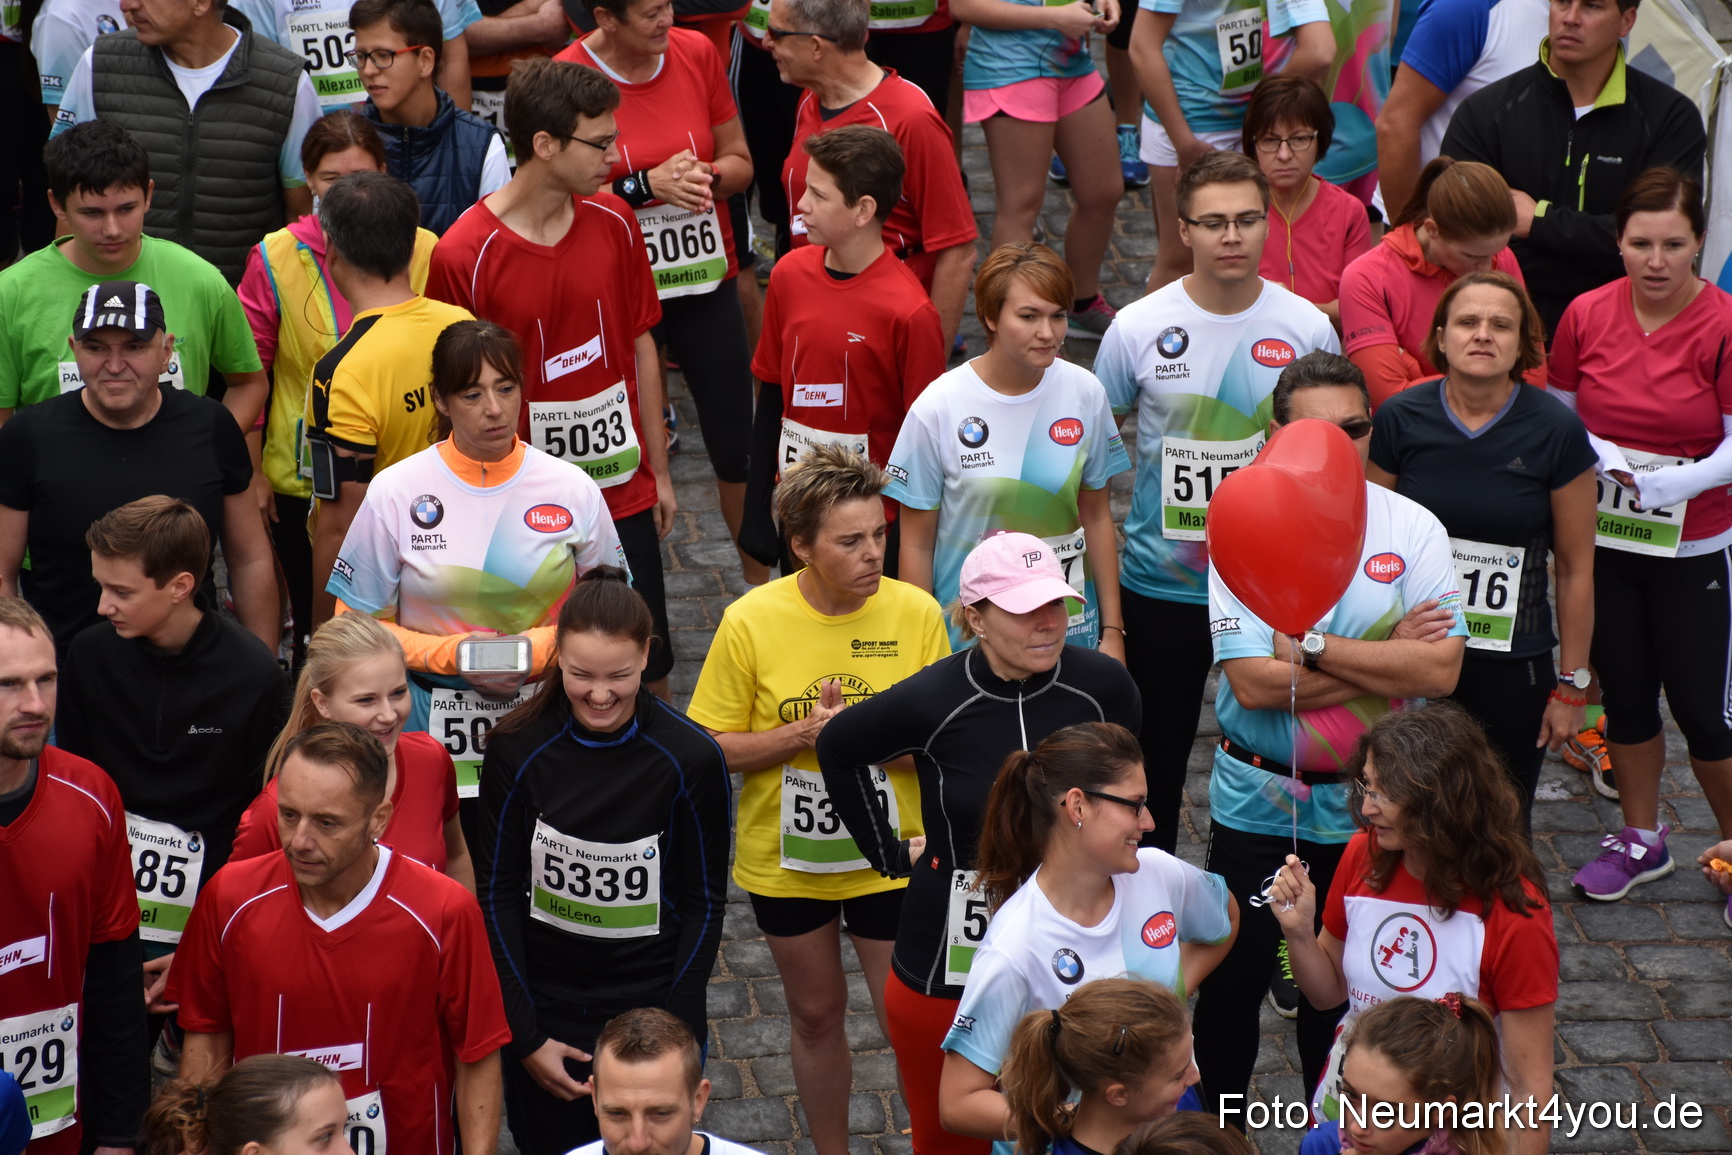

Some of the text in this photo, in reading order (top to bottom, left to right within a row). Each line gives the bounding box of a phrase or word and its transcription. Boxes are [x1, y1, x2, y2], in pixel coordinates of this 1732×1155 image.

[290, 23, 323, 34] PARTL
[1219, 19, 1250, 32] PARTL
[643, 220, 716, 266] 5066
[659, 269, 708, 287] Martina
[562, 350, 588, 368] DEHN
[1257, 344, 1292, 361] Hervis
[1155, 363, 1190, 374] PARTL
[1155, 372, 1190, 381] Neumarkt
[403, 387, 425, 413] SV
[804, 391, 827, 401] DEHN
[533, 399, 614, 422] PARTL Neumarkt
[545, 410, 627, 458] 5033
[783, 427, 803, 444] PARTL
[1054, 424, 1081, 439] Hervis
[960, 451, 994, 463] PARTL
[1166, 447, 1254, 461] PARTL Neumarkt
[961, 460, 995, 470] Neumarkt
[531, 511, 568, 527] Hervis
[411, 534, 447, 544] PARTL
[1022, 551, 1042, 568] P
[433, 700, 473, 711] PARTL
[444, 716, 504, 756] 50
[785, 775, 821, 793] PARTL
[128, 825, 182, 849] Neumarkt
[536, 831, 638, 863] PARTL Neumarkt
[543, 852, 649, 902] 5339
[550, 898, 603, 924] Helena
